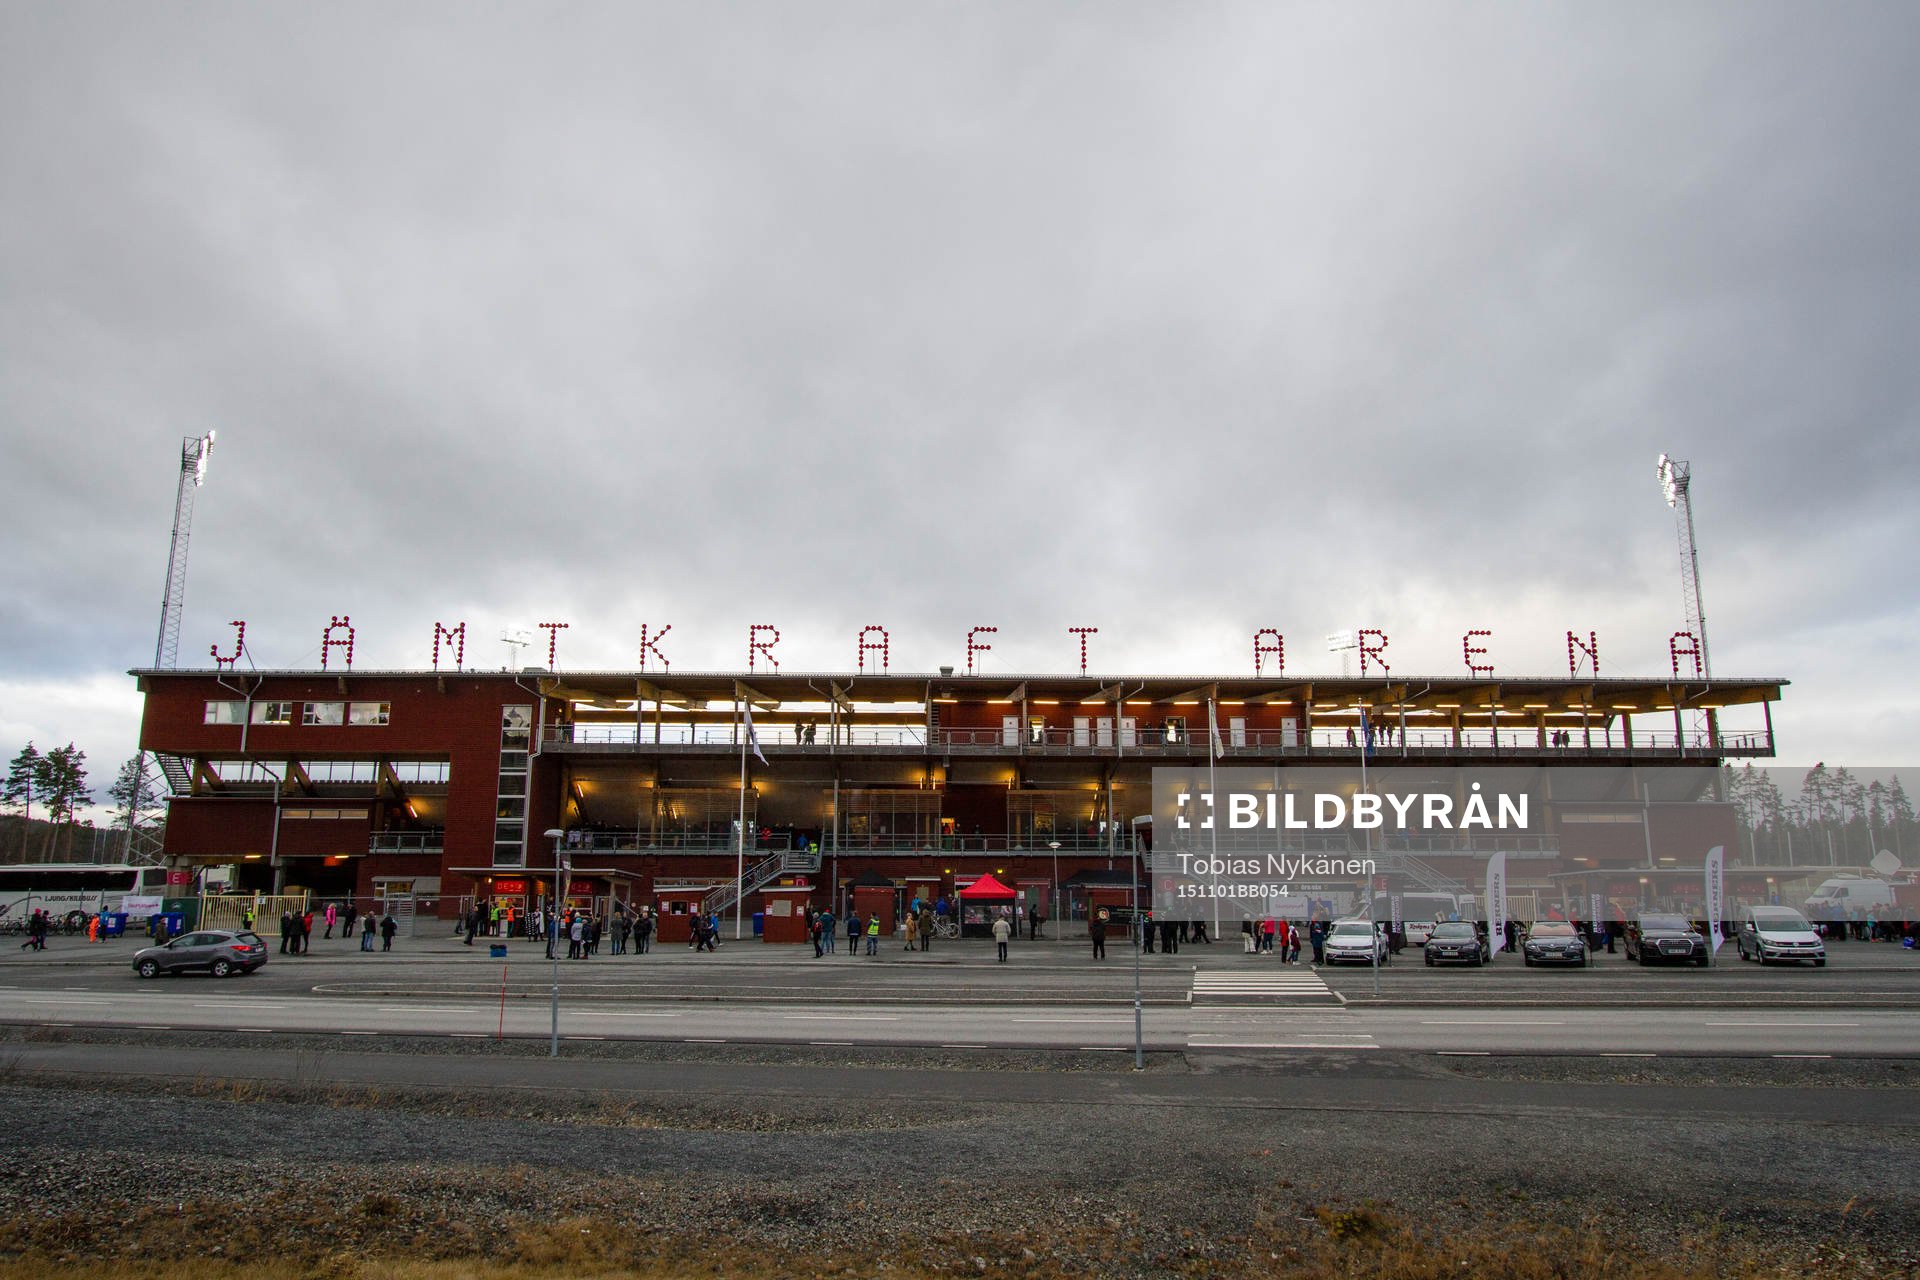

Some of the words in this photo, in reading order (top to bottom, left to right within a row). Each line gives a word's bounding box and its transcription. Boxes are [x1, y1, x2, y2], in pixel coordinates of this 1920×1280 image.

[211, 615, 1098, 668] JÄMTKRAFT
[1253, 628, 1702, 673] ARENA
[1493, 872, 1503, 937] BERNERS
